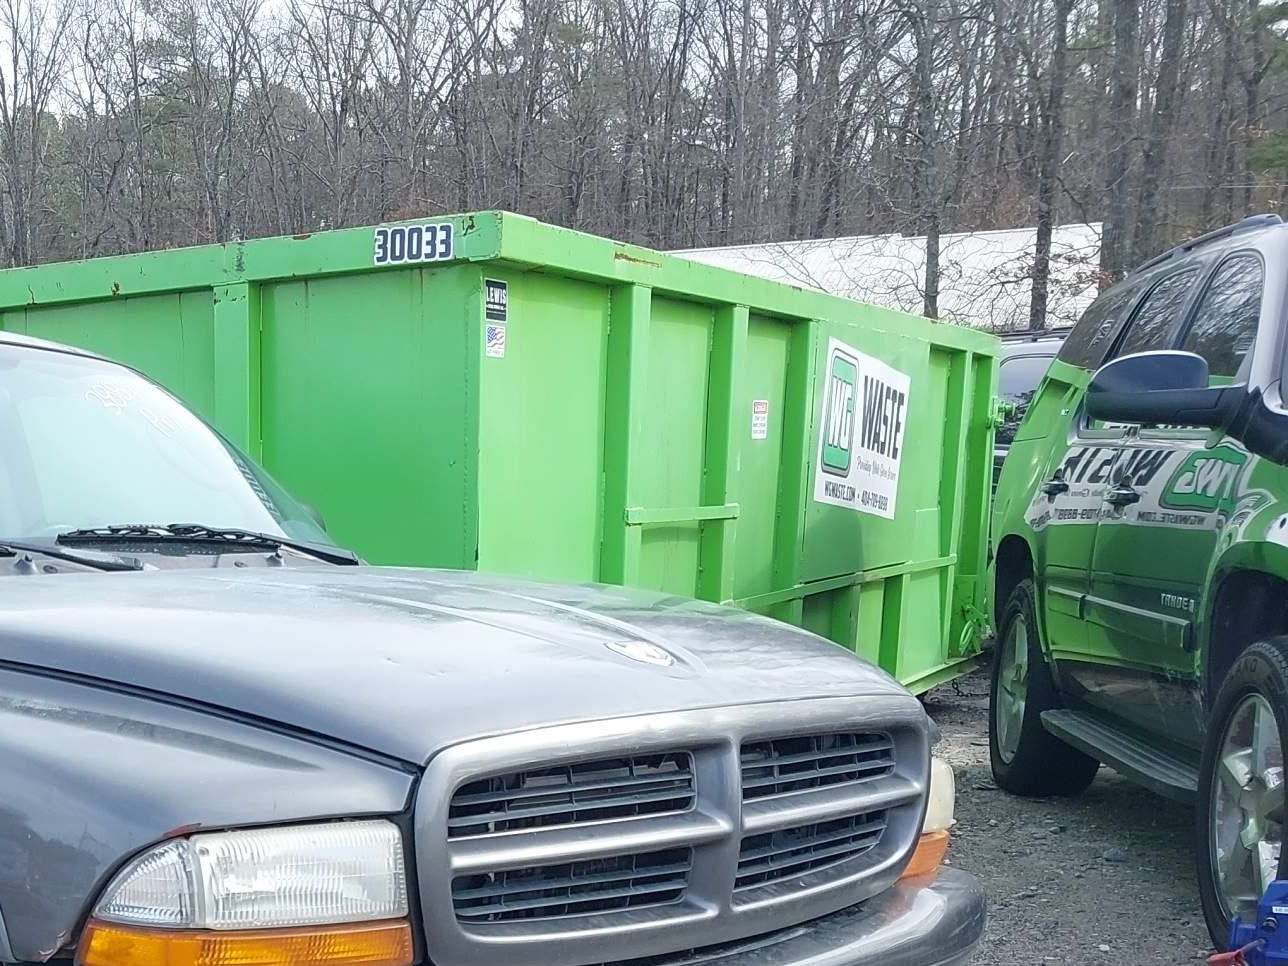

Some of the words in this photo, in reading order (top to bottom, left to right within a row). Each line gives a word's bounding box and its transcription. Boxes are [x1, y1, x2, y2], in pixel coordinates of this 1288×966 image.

[375, 224, 453, 263] 30033
[861, 375, 905, 460] WASTE
[1160, 593, 1189, 610] TAHOE
